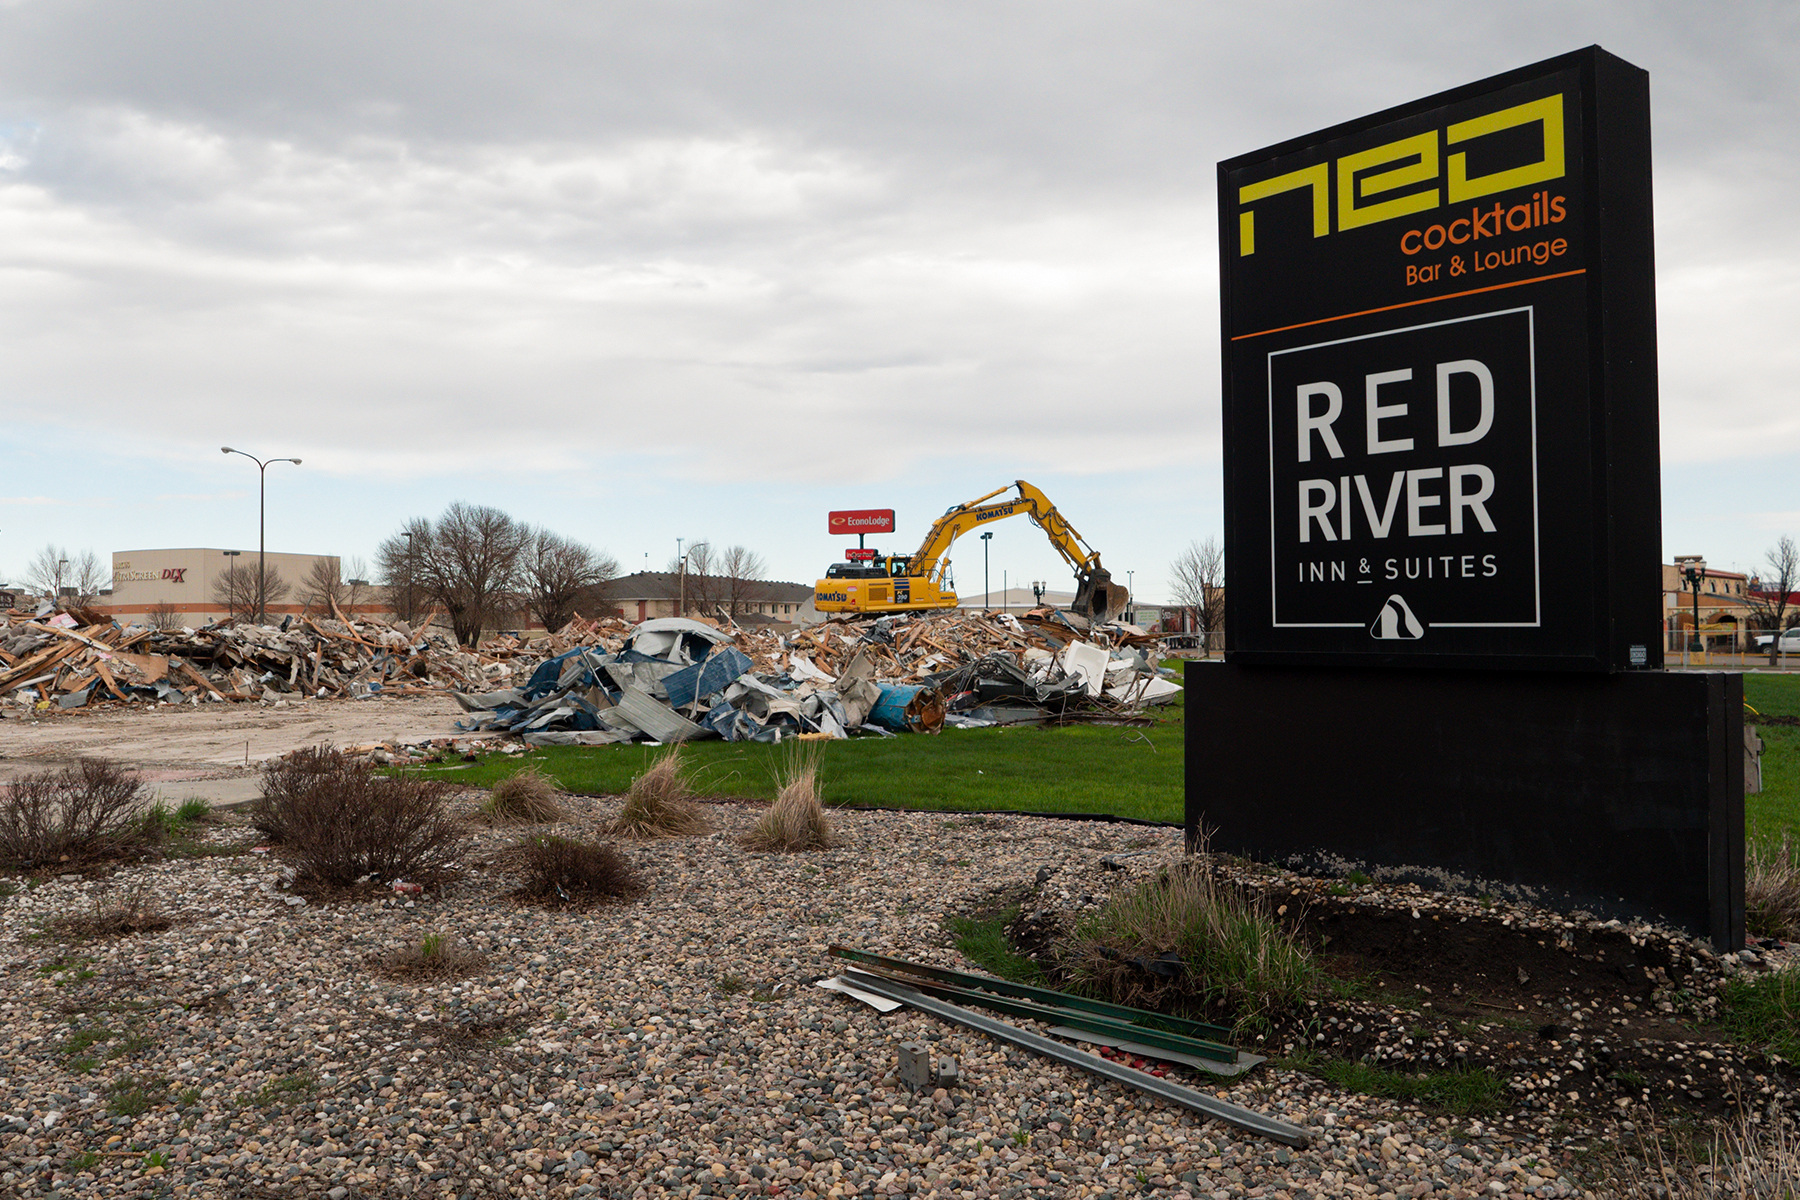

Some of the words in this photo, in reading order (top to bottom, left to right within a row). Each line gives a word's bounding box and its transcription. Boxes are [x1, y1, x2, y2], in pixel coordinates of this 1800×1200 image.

[1400, 191, 1566, 255] cocktails
[1406, 263, 1441, 286] Bar
[1450, 254, 1467, 277] &
[1474, 238, 1568, 273] Lounge
[1297, 359, 1495, 462] RED
[976, 506, 1014, 521] KOMATSU
[1299, 464, 1498, 542] RIVER
[161, 568, 187, 583] DLX
[1298, 561, 1345, 583] INN
[1357, 558, 1372, 576] &
[1384, 555, 1498, 580] SUITES
[816, 591, 847, 602] KOMATSU
